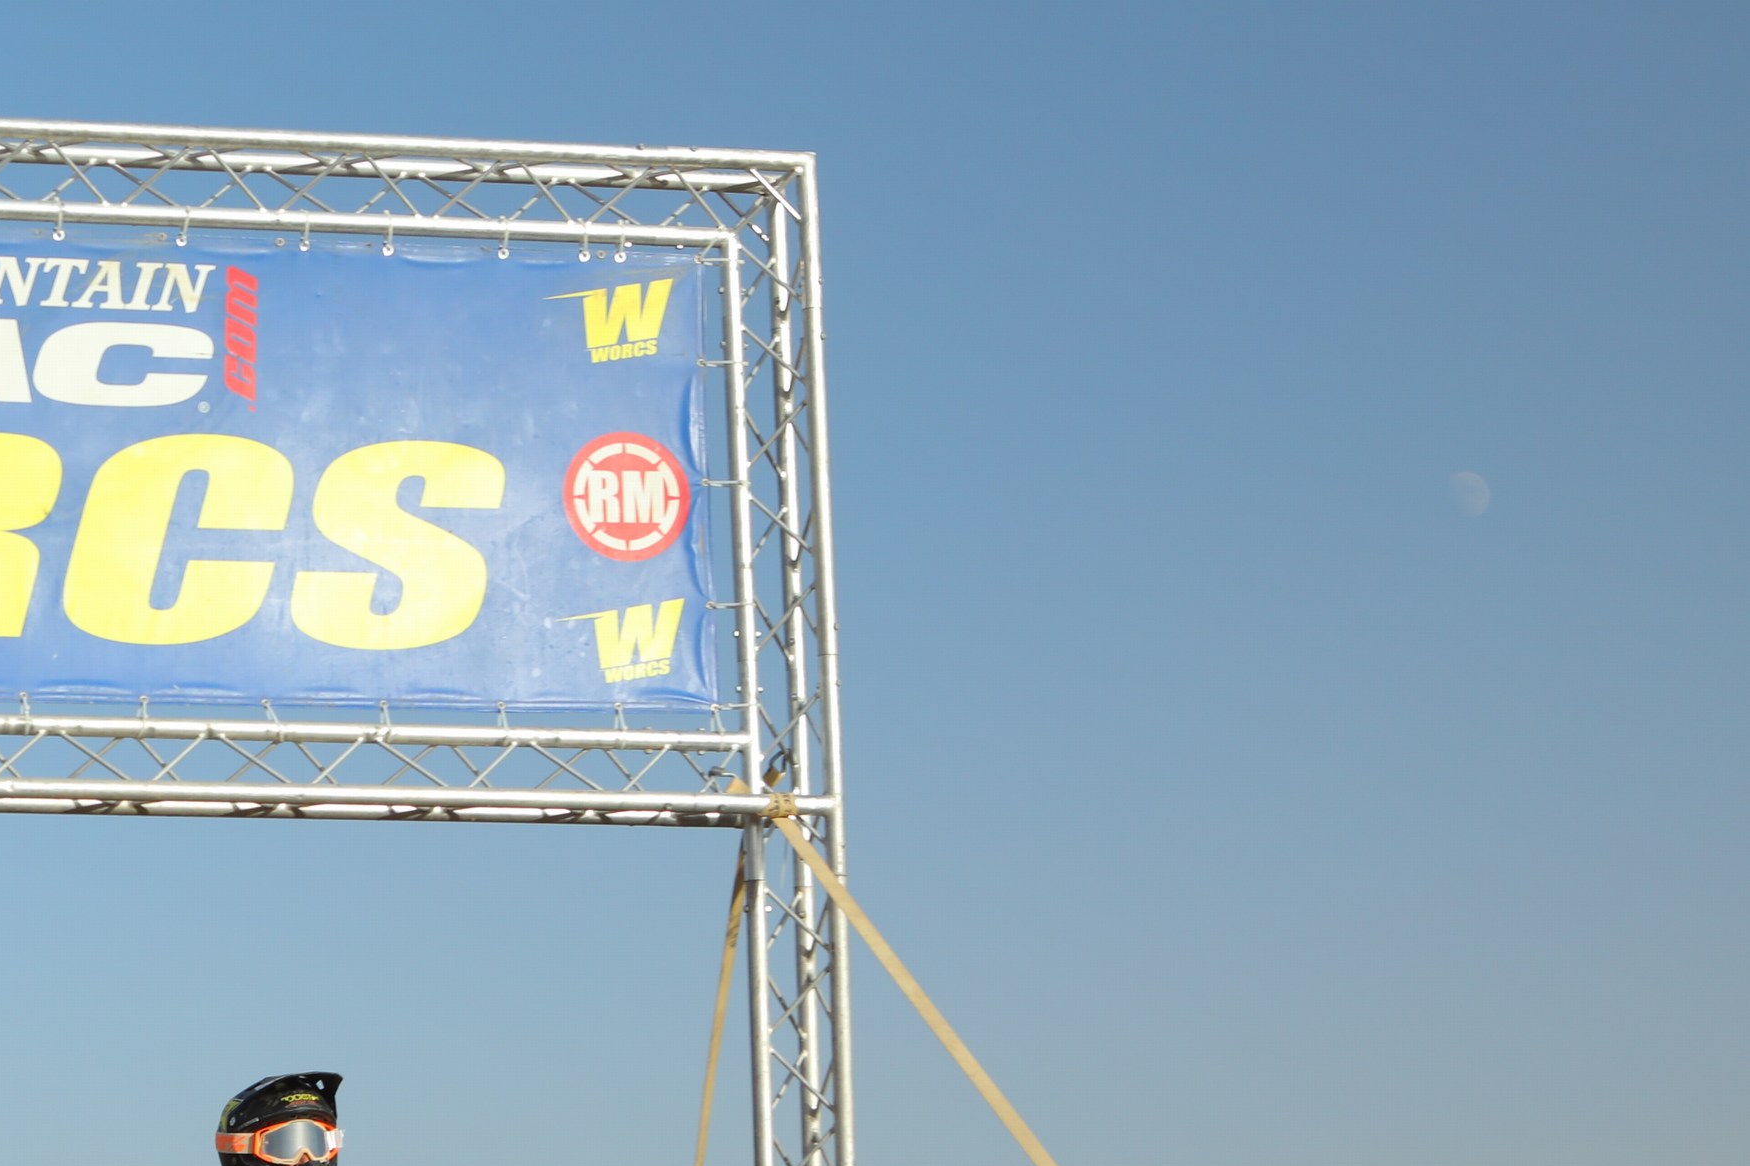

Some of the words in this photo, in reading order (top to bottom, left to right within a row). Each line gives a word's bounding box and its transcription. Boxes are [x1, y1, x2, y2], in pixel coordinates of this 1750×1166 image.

[542, 278, 674, 350] W
[590, 339, 659, 364] WORCS
[585, 470, 668, 525] RM
[555, 598, 686, 670] W
[604, 659, 671, 684] WORCS
